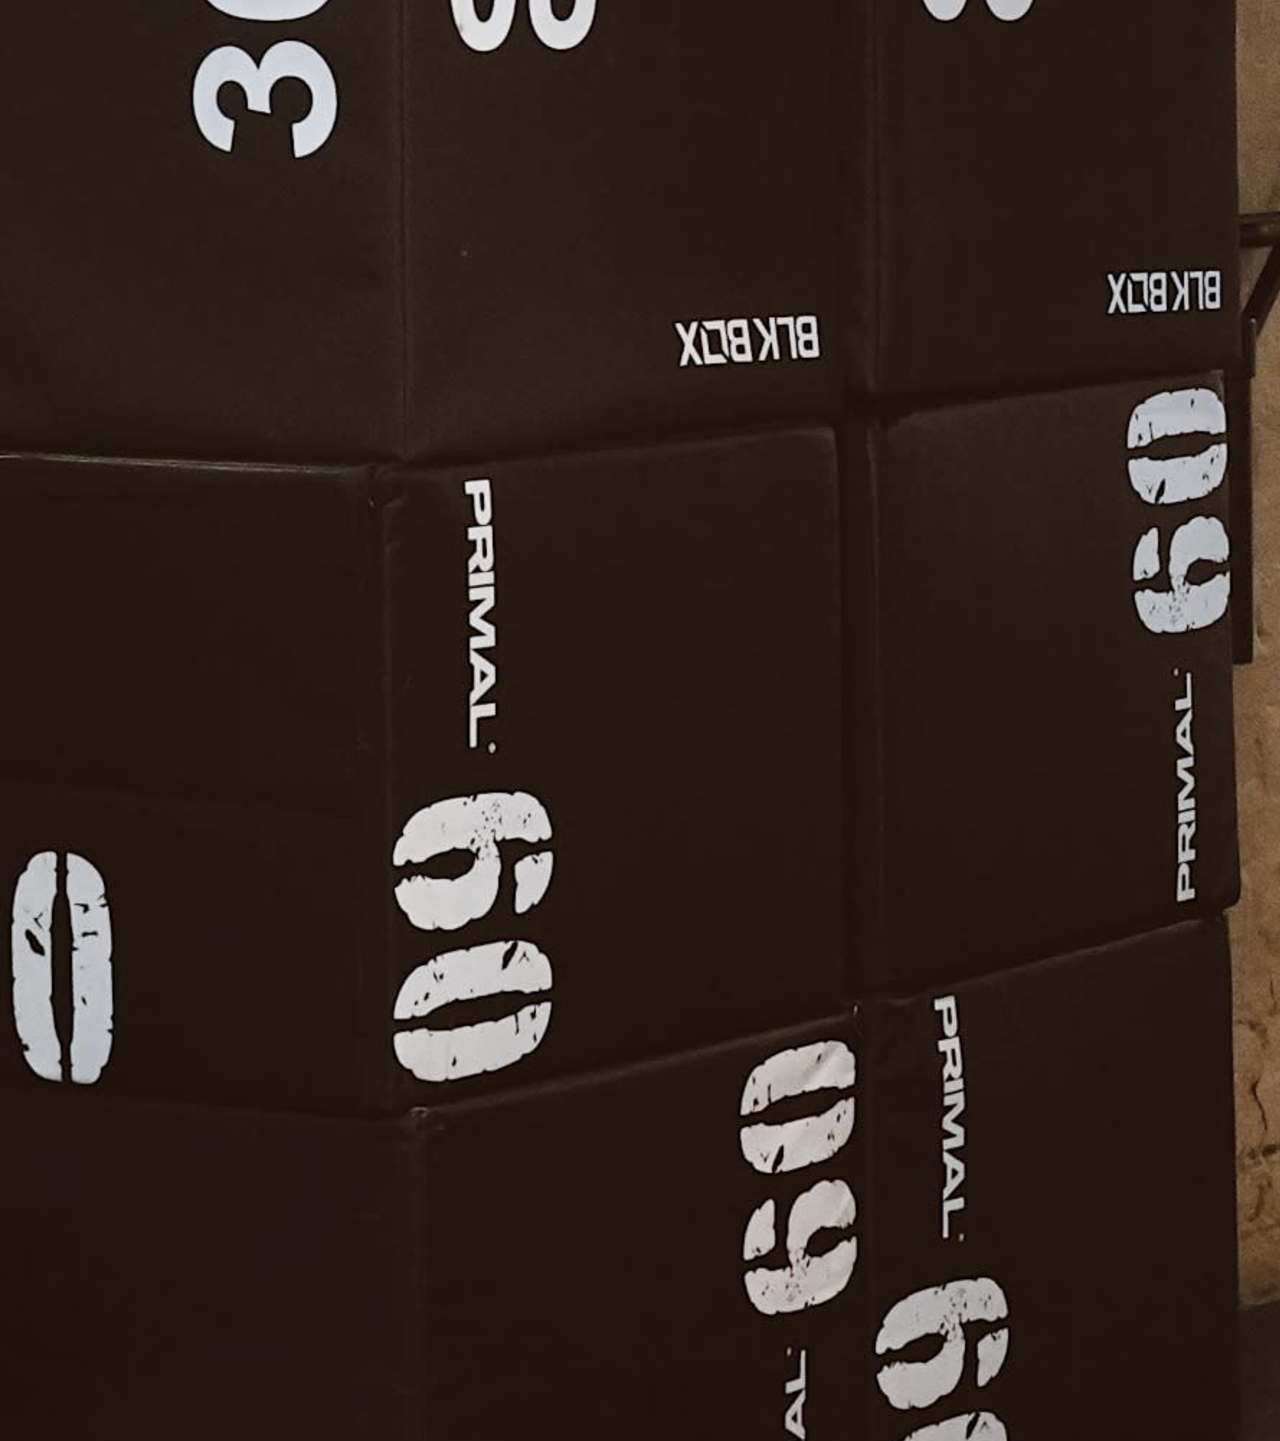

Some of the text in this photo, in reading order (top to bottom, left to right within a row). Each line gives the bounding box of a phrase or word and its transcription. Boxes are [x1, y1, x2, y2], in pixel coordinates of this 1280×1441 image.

[464, 479, 497, 750] PRIMAL
[1127, 387, 1231, 634] 60
[1173, 673, 1196, 902] PRIMAL
[392, 791, 554, 1082] 60
[739, 1040, 857, 1315] 60
[933, 995, 965, 1240] PRIMAL
